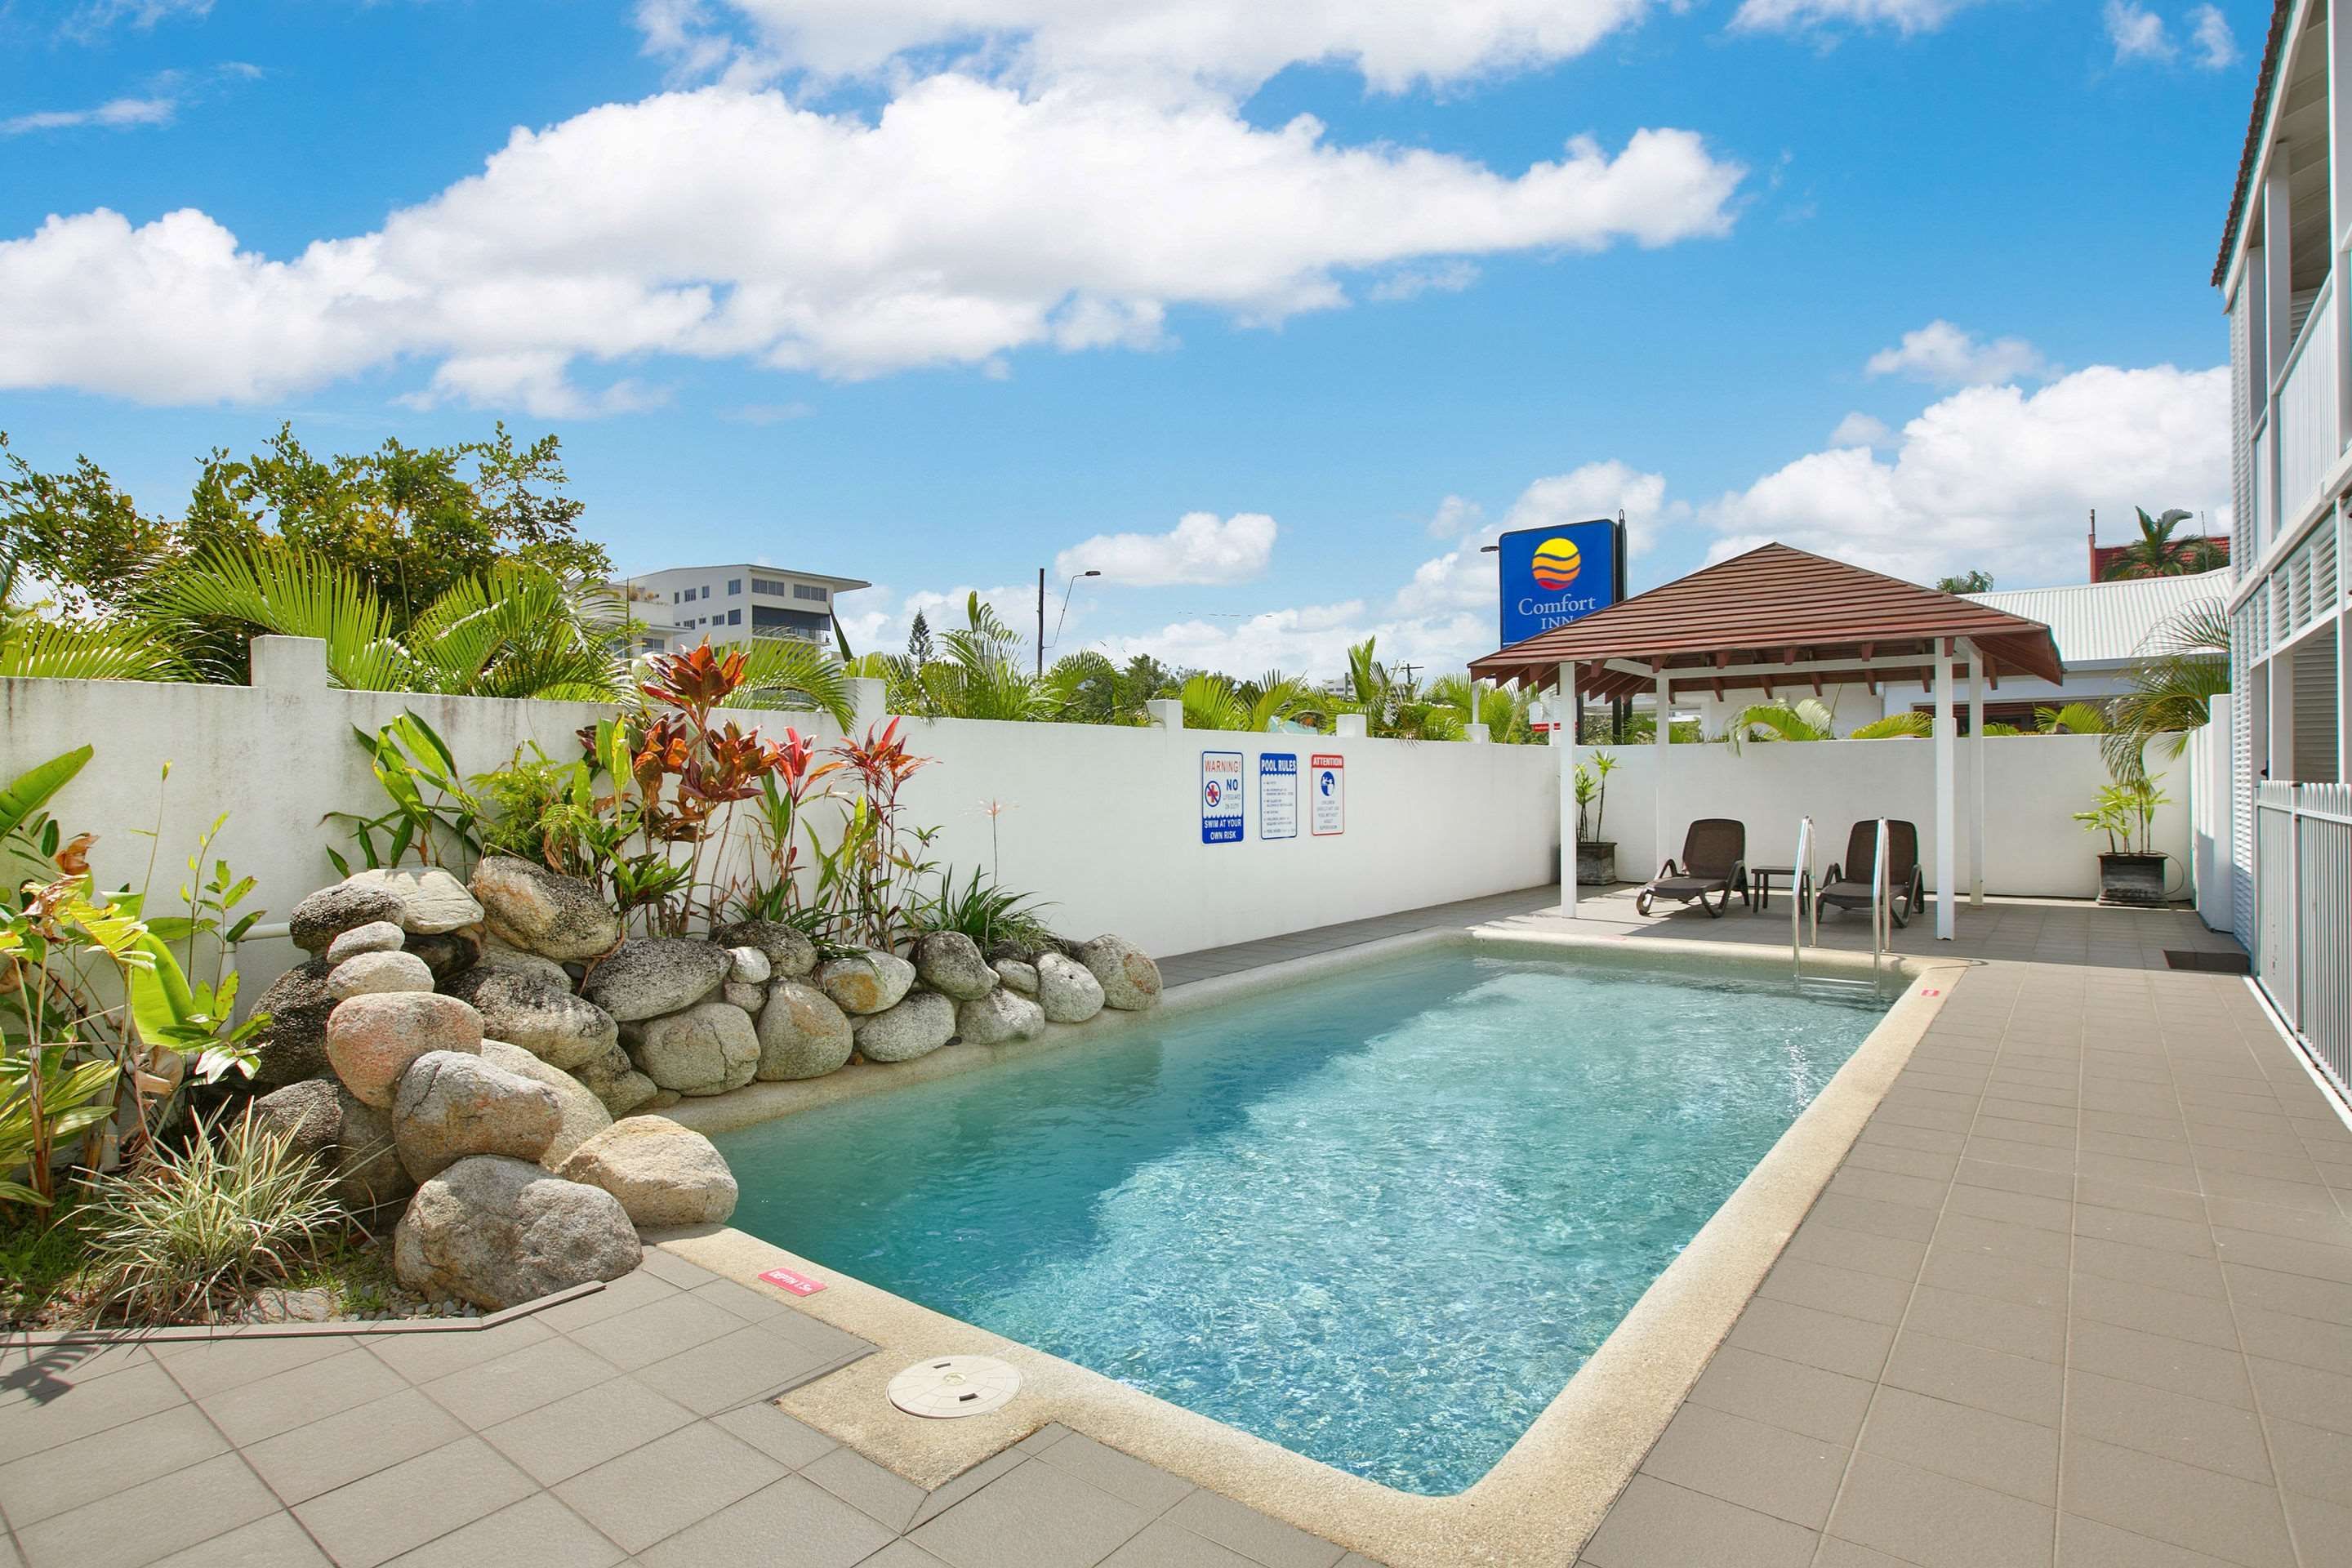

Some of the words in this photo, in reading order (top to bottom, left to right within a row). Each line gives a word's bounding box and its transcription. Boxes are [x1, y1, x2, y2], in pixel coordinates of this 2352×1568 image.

[1518, 594, 1596, 615] Comfort
[1205, 760, 1241, 773] WARNING!
[1262, 760, 1276, 772] POOL
[1278, 760, 1296, 772] RULES
[1313, 757, 1343, 766] ATTENTION
[1227, 779, 1238, 791] NO
[1205, 820, 1218, 828] SWIM
[1227, 819, 1241, 827] YOUR
[1210, 832, 1223, 840] OWN
[1224, 831, 1236, 839] RISK
